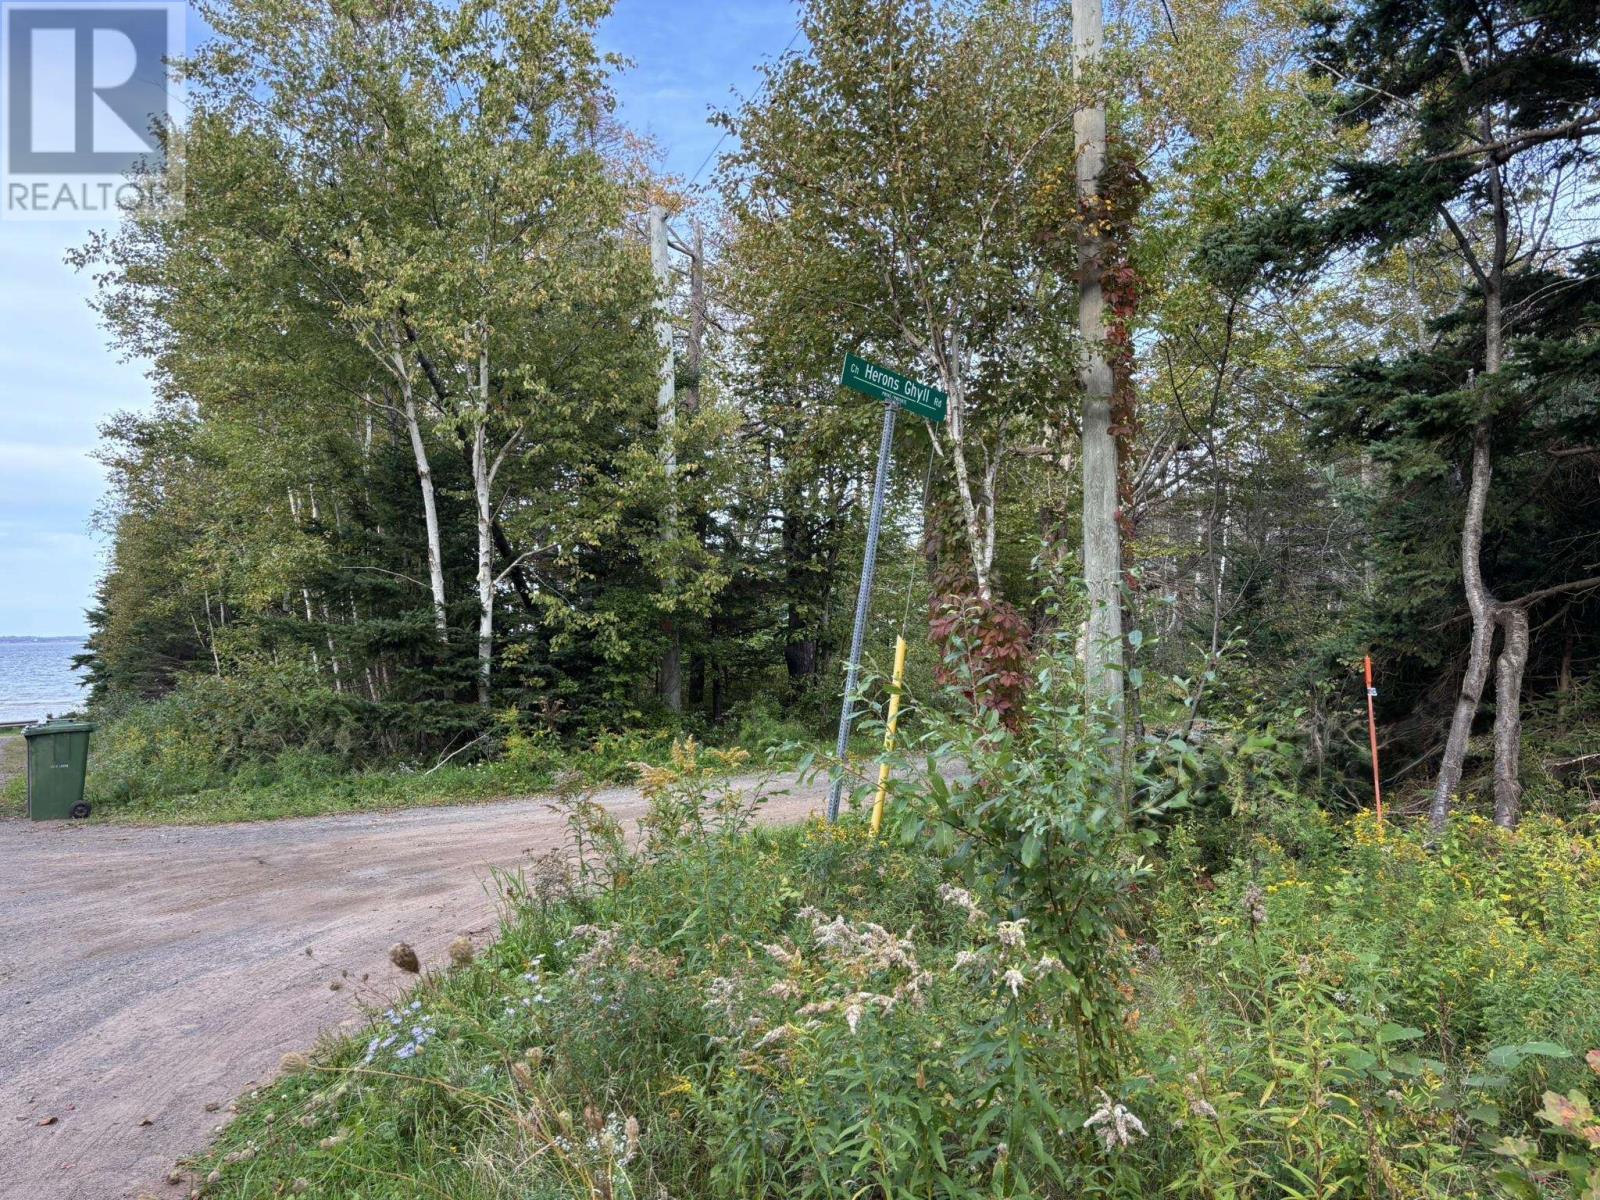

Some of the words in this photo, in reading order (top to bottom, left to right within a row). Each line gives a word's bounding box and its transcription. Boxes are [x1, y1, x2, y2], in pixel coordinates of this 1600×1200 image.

[850, 363, 860, 375] Ch
[864, 363, 900, 391] Herons
[904, 381, 930, 403] Ghyll
[933, 397, 942, 408] Rd
